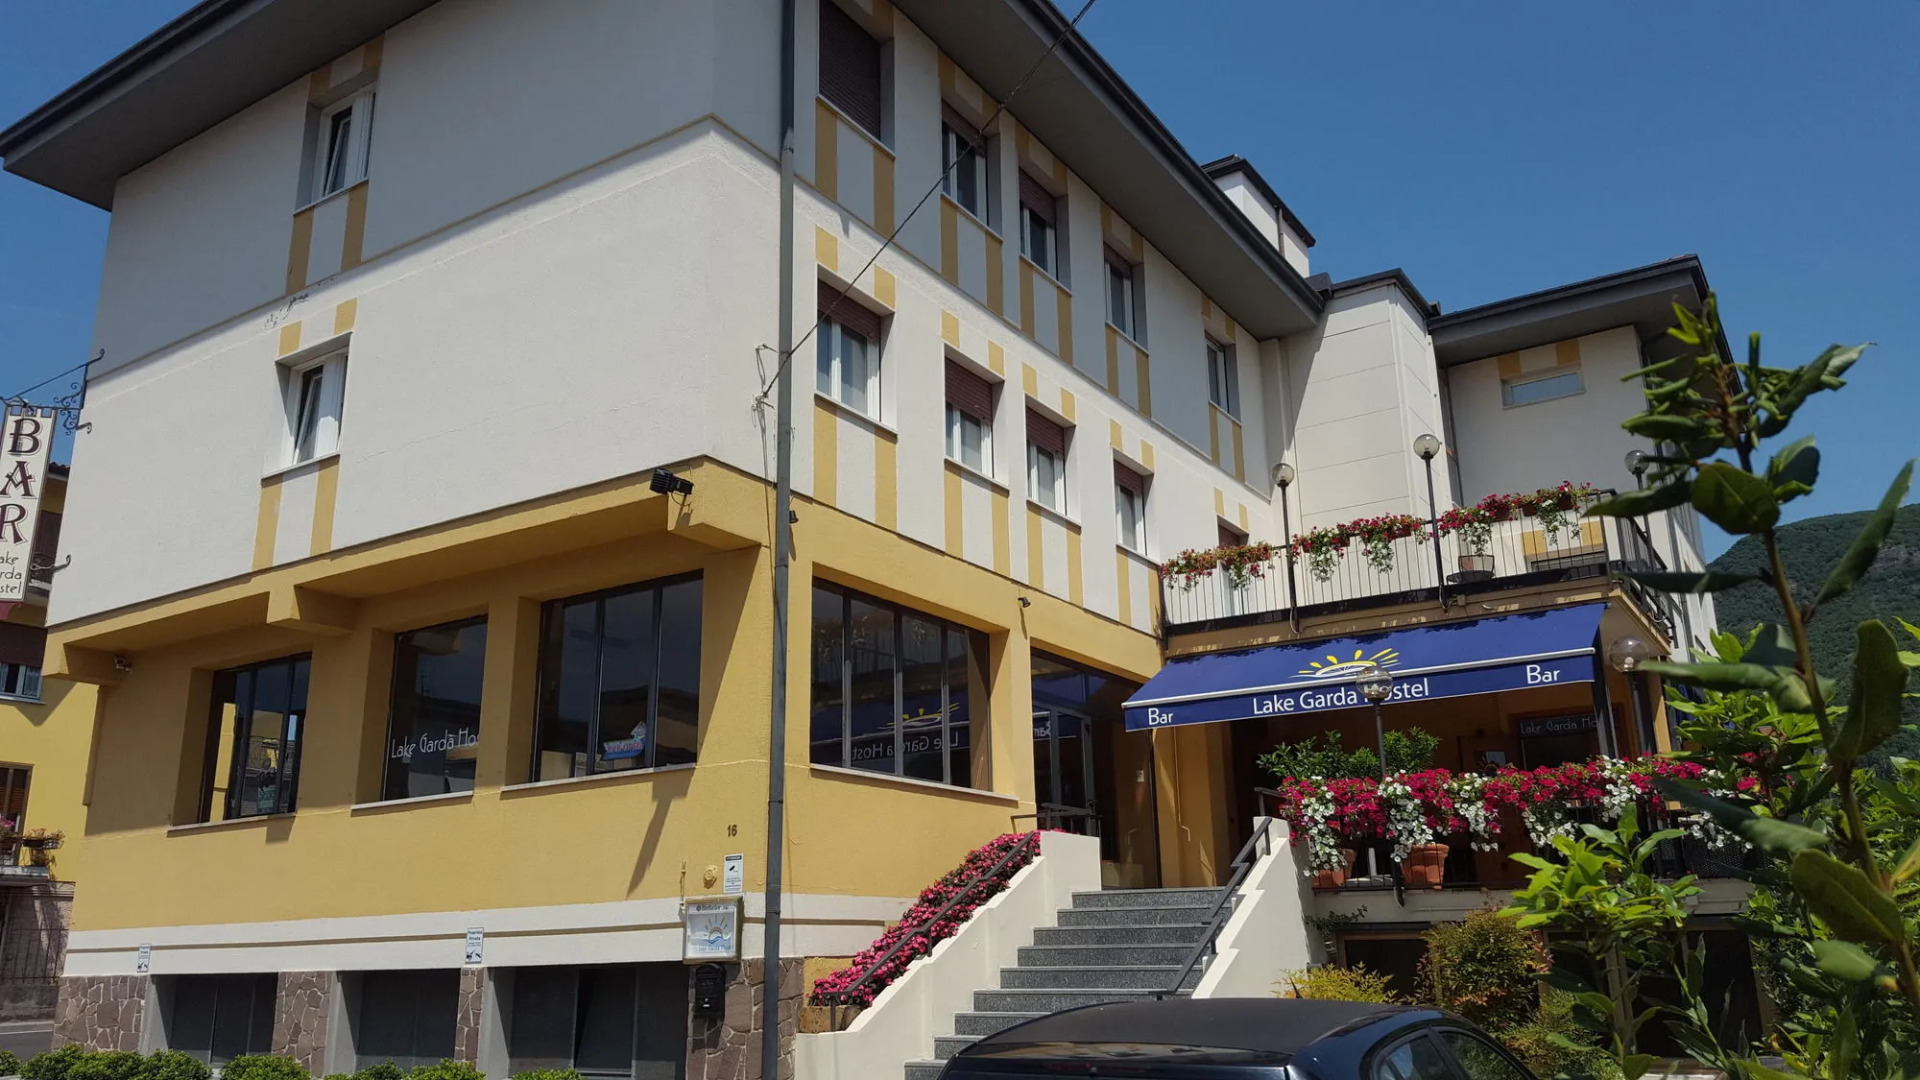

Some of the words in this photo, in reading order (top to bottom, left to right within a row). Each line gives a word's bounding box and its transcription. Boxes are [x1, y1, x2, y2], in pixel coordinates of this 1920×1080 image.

[0, 418, 43, 545] BAR
[0, 551, 19, 565] ake
[0, 566, 22, 580] rda
[0, 582, 22, 595] stel
[1526, 664, 1560, 684] Bar
[1252, 694, 1295, 715] Lake
[1299, 687, 1358, 709] Garda
[1147, 707, 1173, 725] Bar
[1520, 722, 1542, 735] Lake
[1546, 719, 1577, 732] Garda
[391, 735, 417, 758] Lake
[419, 729, 455, 753] Garda
